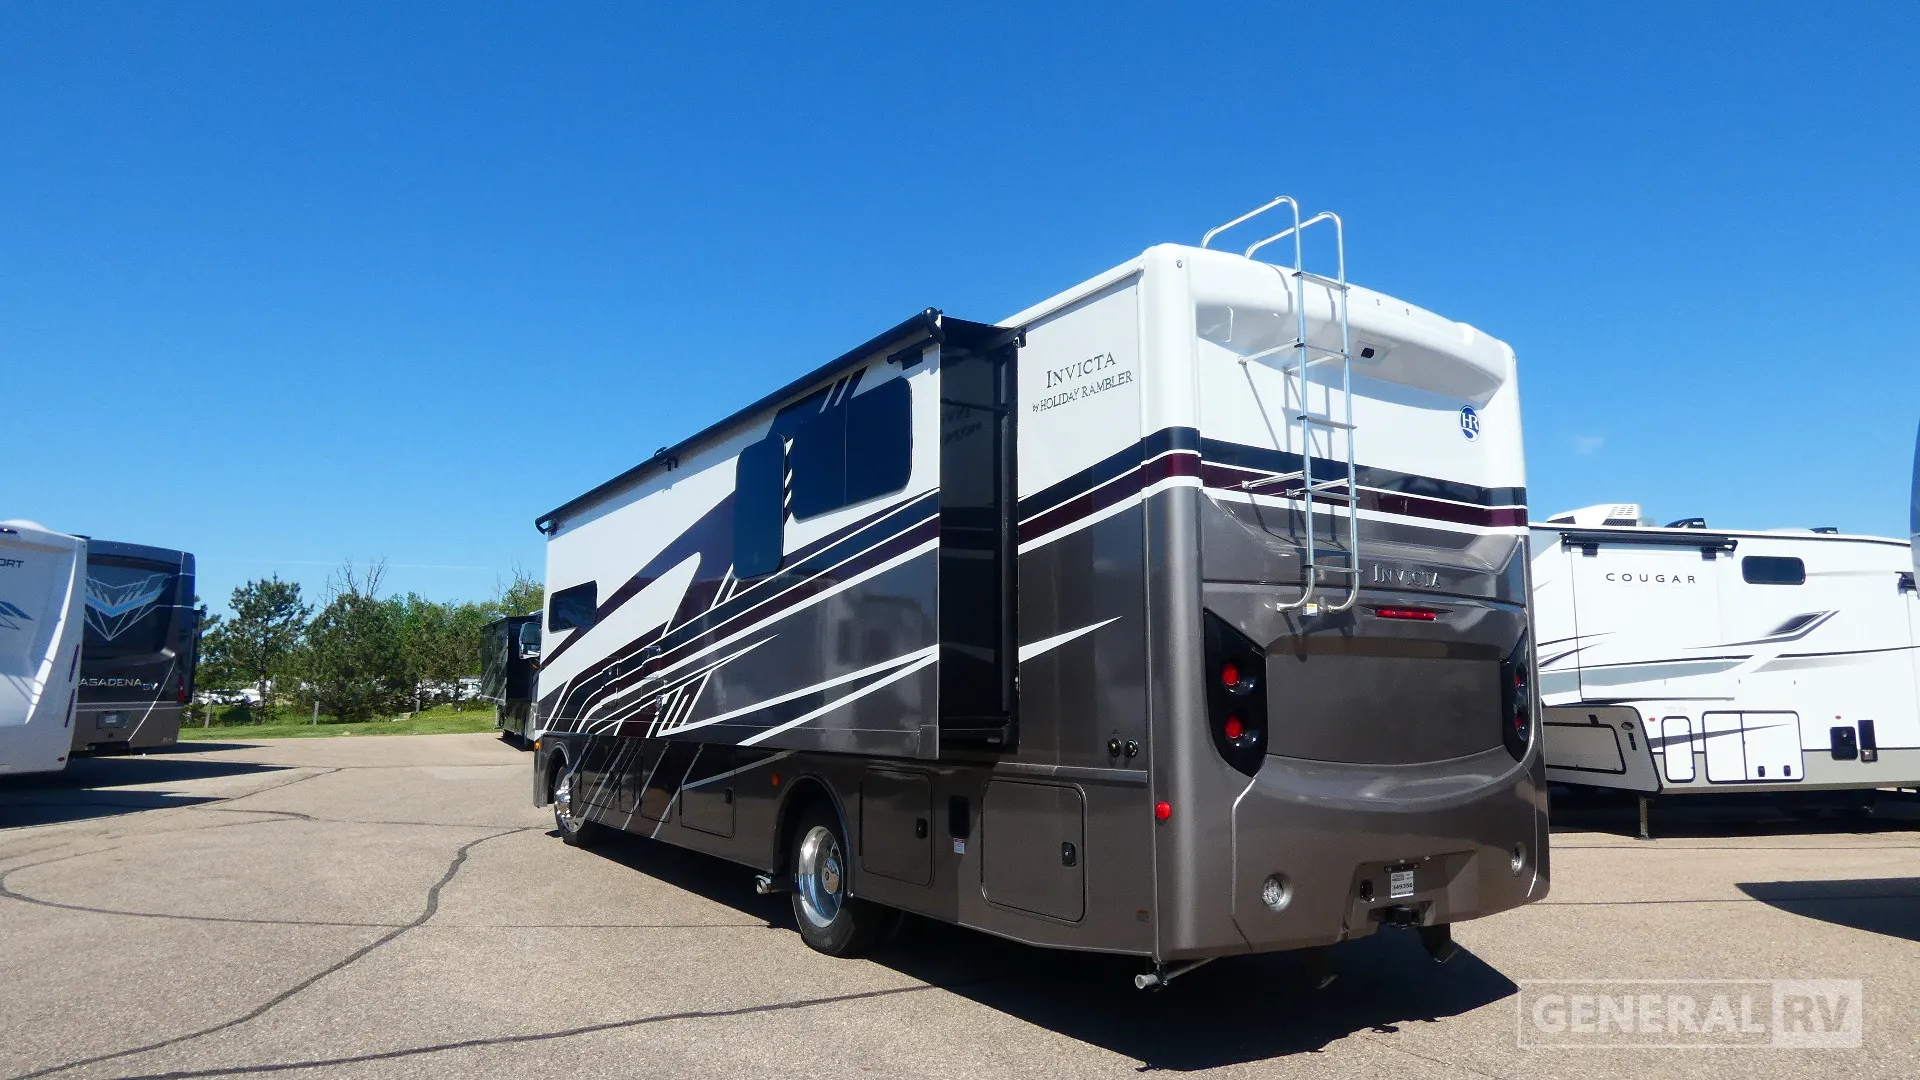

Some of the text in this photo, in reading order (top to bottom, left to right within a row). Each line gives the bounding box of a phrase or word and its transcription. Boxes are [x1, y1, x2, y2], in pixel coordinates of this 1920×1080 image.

[1046, 351, 1117, 389] INVICTA
[1032, 370, 1133, 413] by HOLIDAY RAMBLER
[1372, 563, 1441, 588] INVICTA
[1605, 572, 1696, 584] COUGAR
[79, 678, 142, 687] ASADENA
